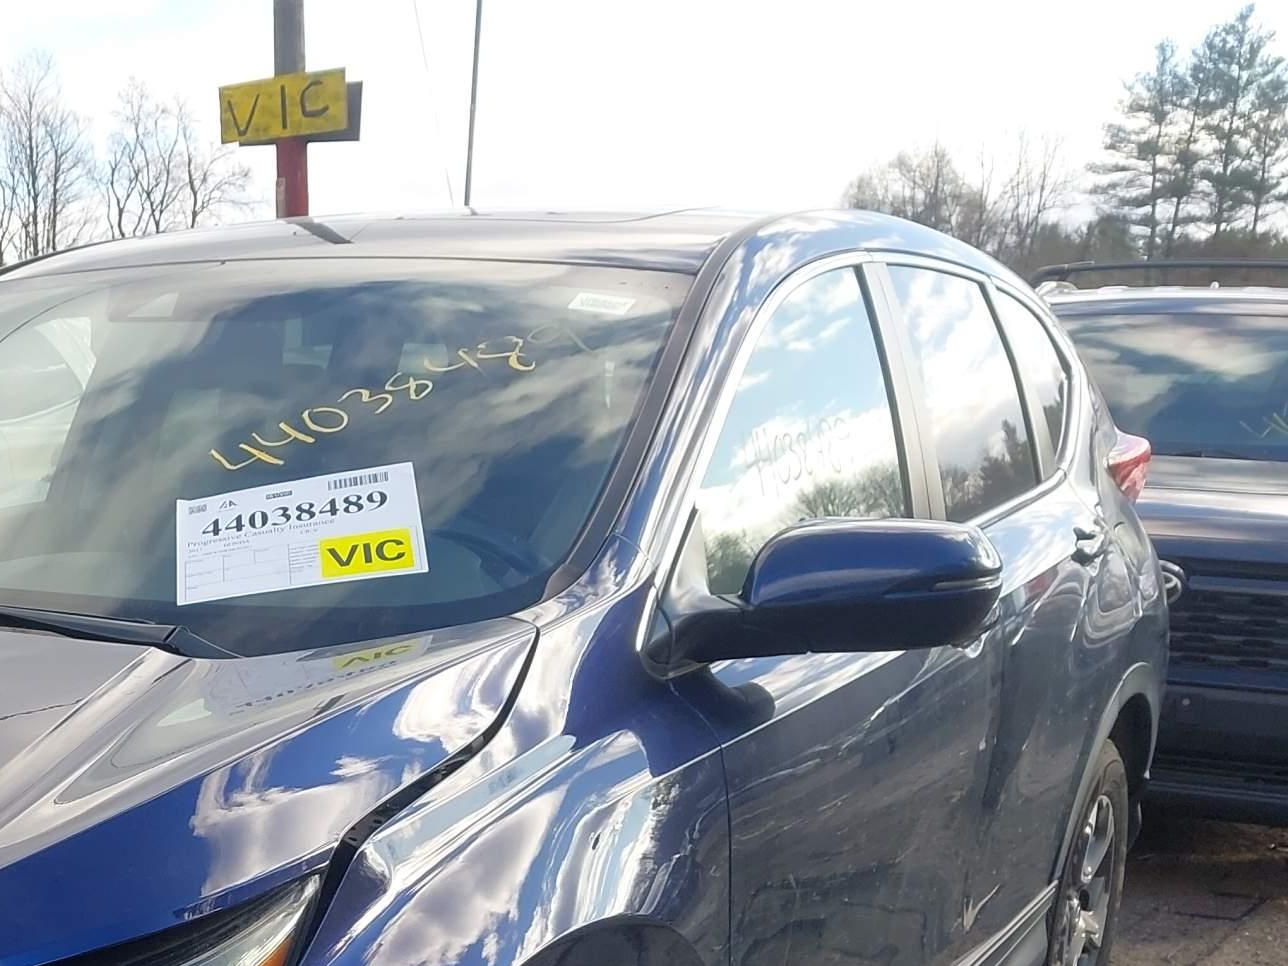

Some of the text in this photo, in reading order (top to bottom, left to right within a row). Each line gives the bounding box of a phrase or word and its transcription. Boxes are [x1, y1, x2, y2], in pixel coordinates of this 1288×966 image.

[227, 81, 329, 136] VIC
[201, 490, 388, 537] 44038489
[327, 539, 406, 567] VIC
